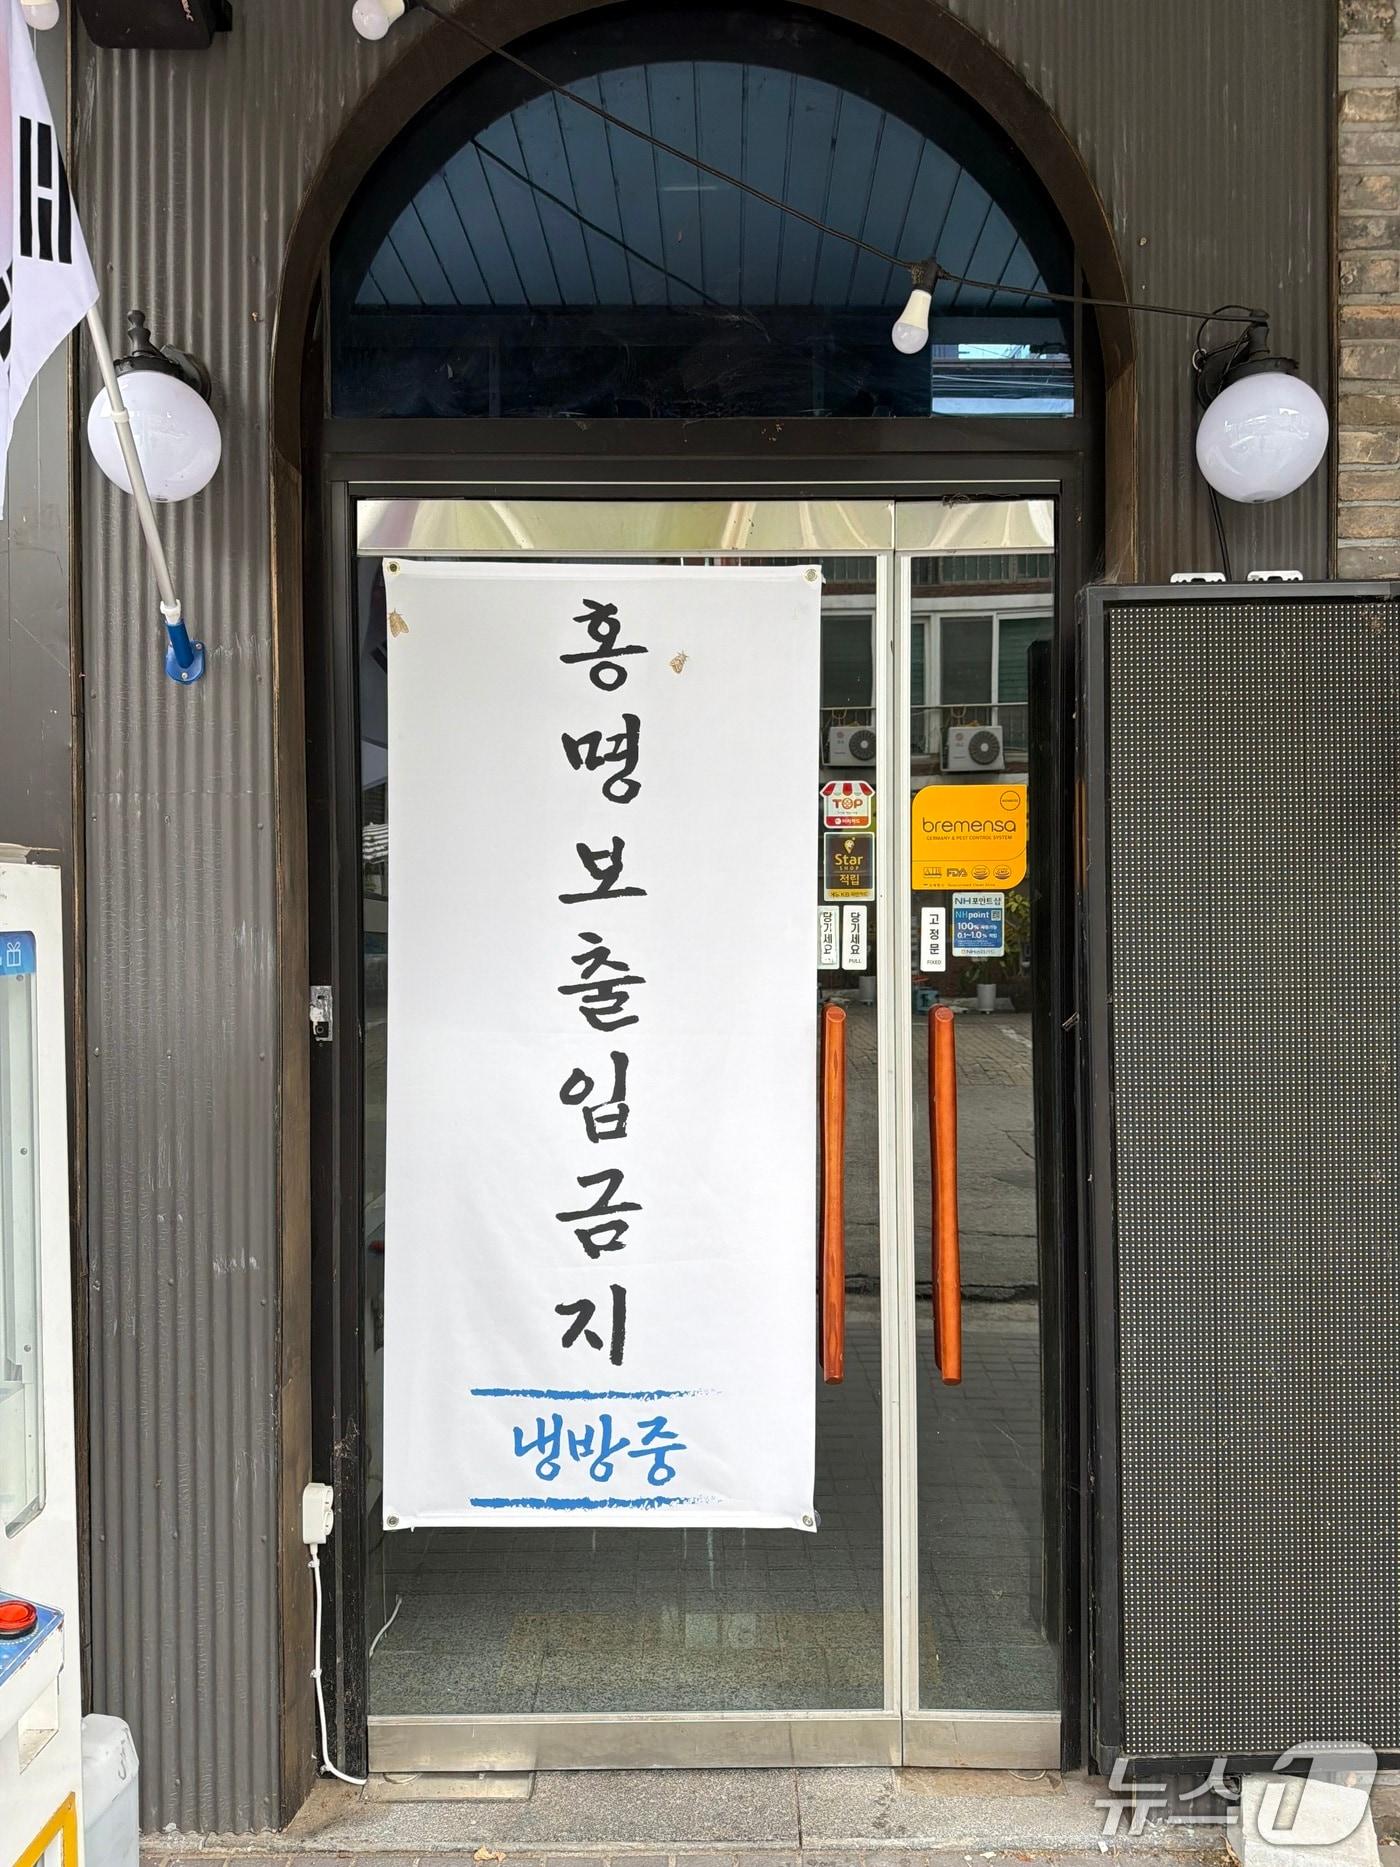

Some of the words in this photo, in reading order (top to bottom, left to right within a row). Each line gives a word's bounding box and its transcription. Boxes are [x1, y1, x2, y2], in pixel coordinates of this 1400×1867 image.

[922, 817, 1016, 833] bremensa
[834, 853, 863, 866] Star
[840, 874, 860, 886] 적립
[946, 868, 968, 878] FDA
[954, 896, 1001, 906] NH포인트샵
[955, 911, 990, 921] NHpoint
[823, 911, 833, 954] 당기세요
[850, 911, 861, 954] 당기세요
[929, 913, 939, 955] 고정문
[555, 598, 648, 1365] 홍명보출입금지
[512, 1412, 687, 1486] 냉방중
